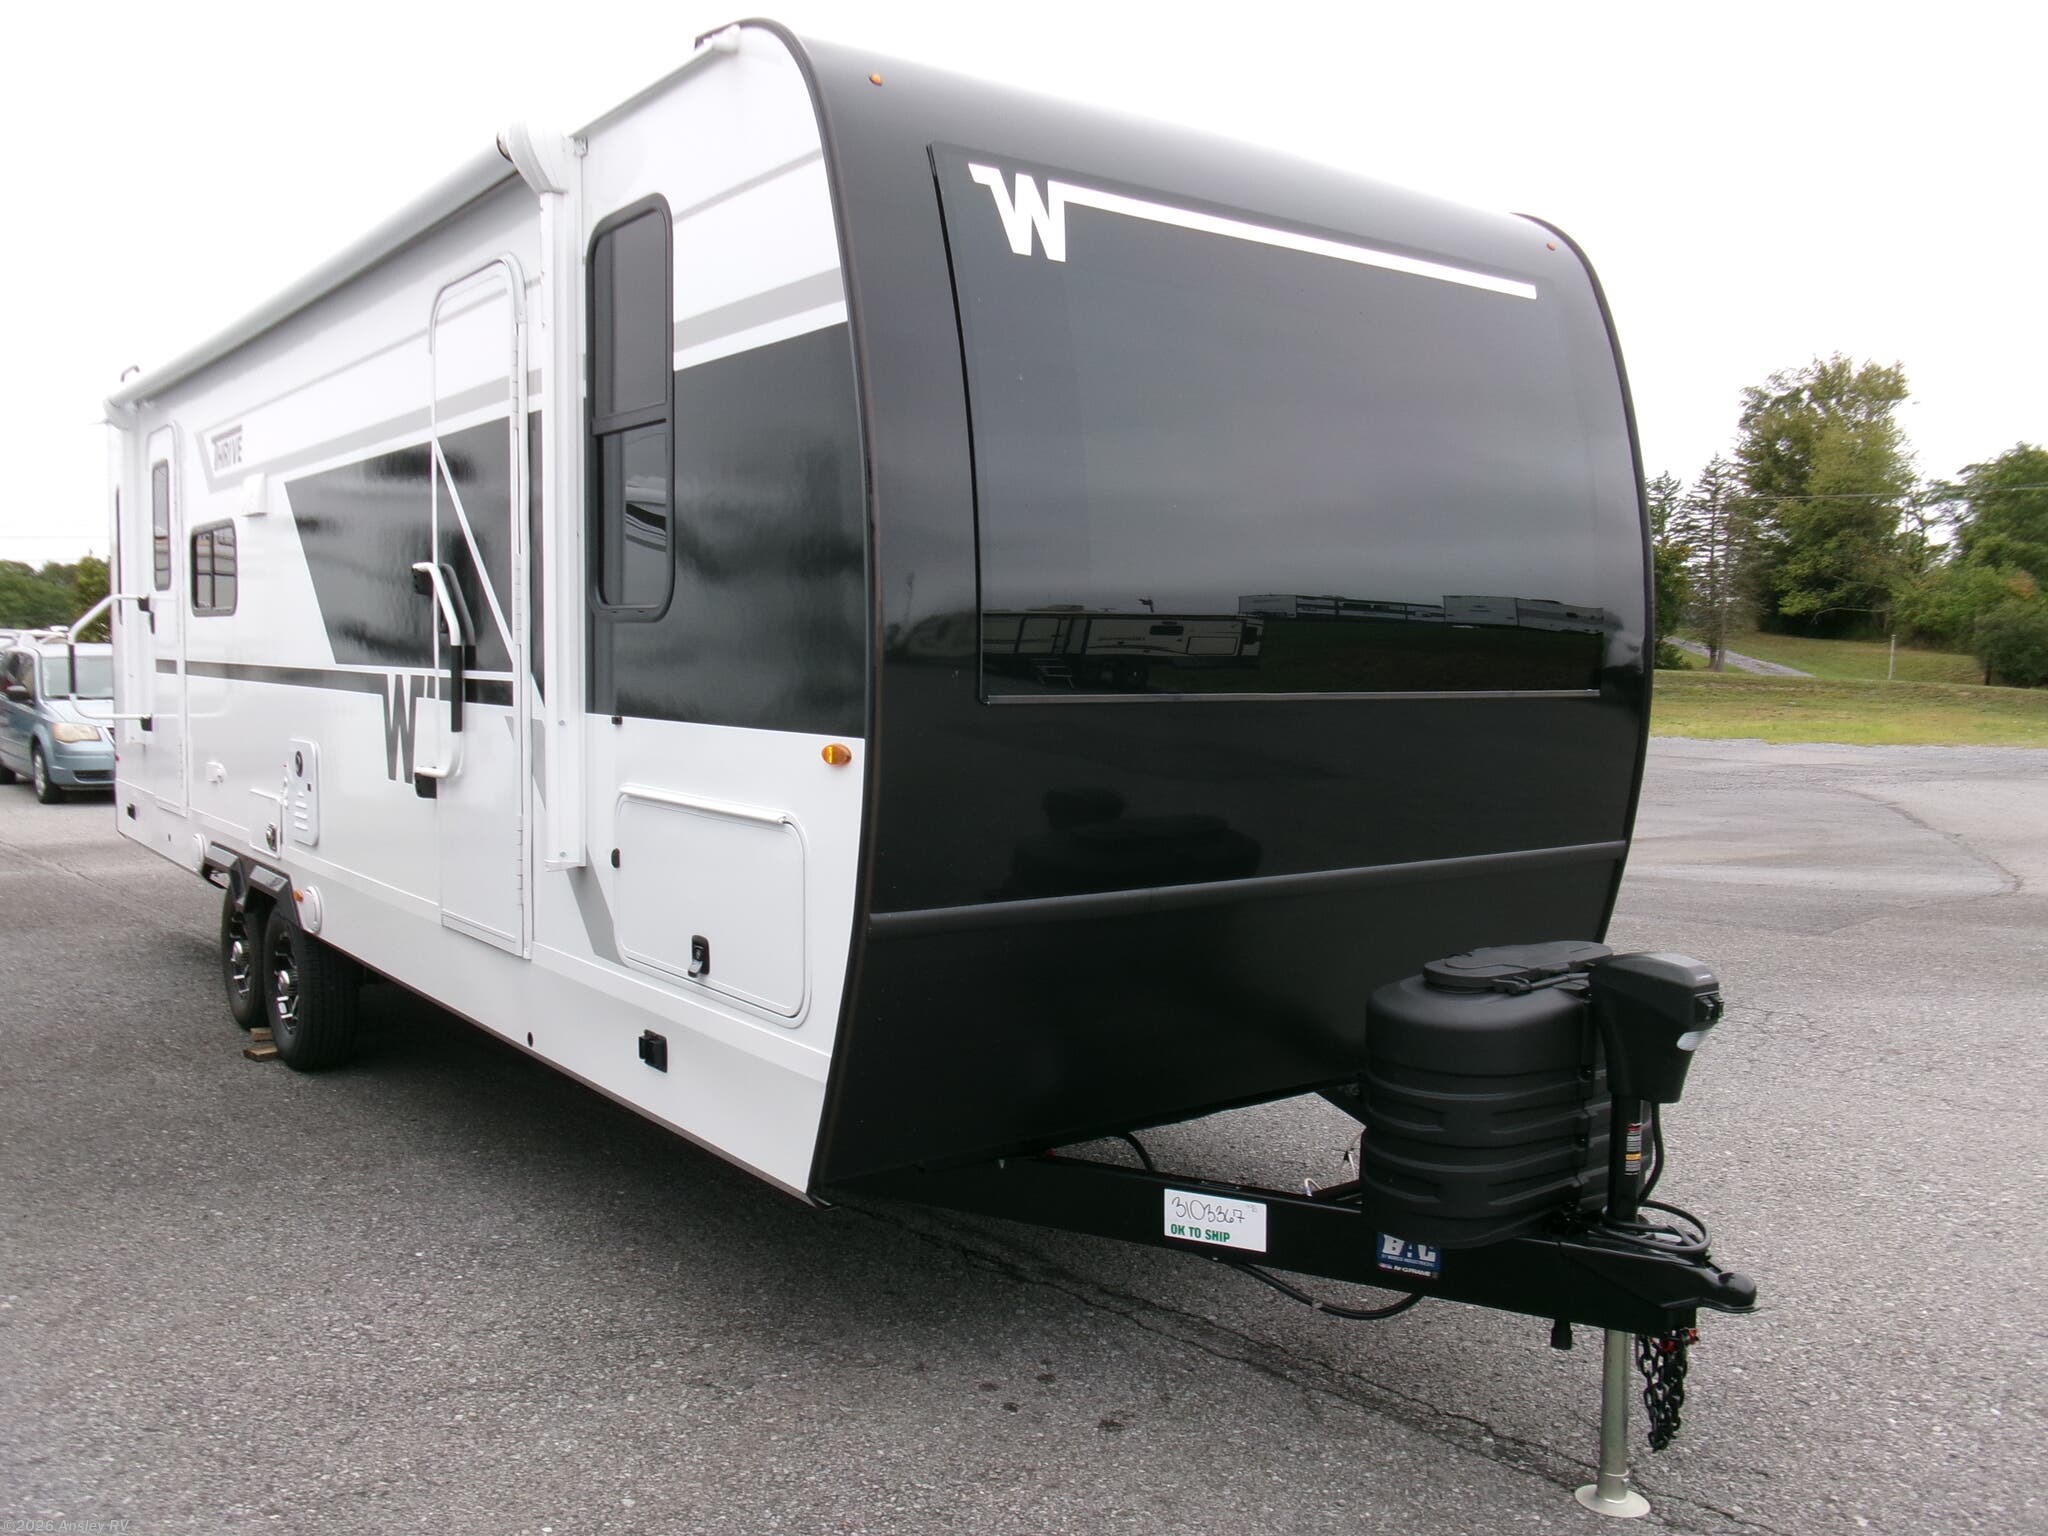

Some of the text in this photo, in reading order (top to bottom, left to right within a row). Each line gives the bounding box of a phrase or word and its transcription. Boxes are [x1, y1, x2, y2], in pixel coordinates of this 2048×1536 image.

[1170, 1223, 1230, 1243] OK TO SHIP
